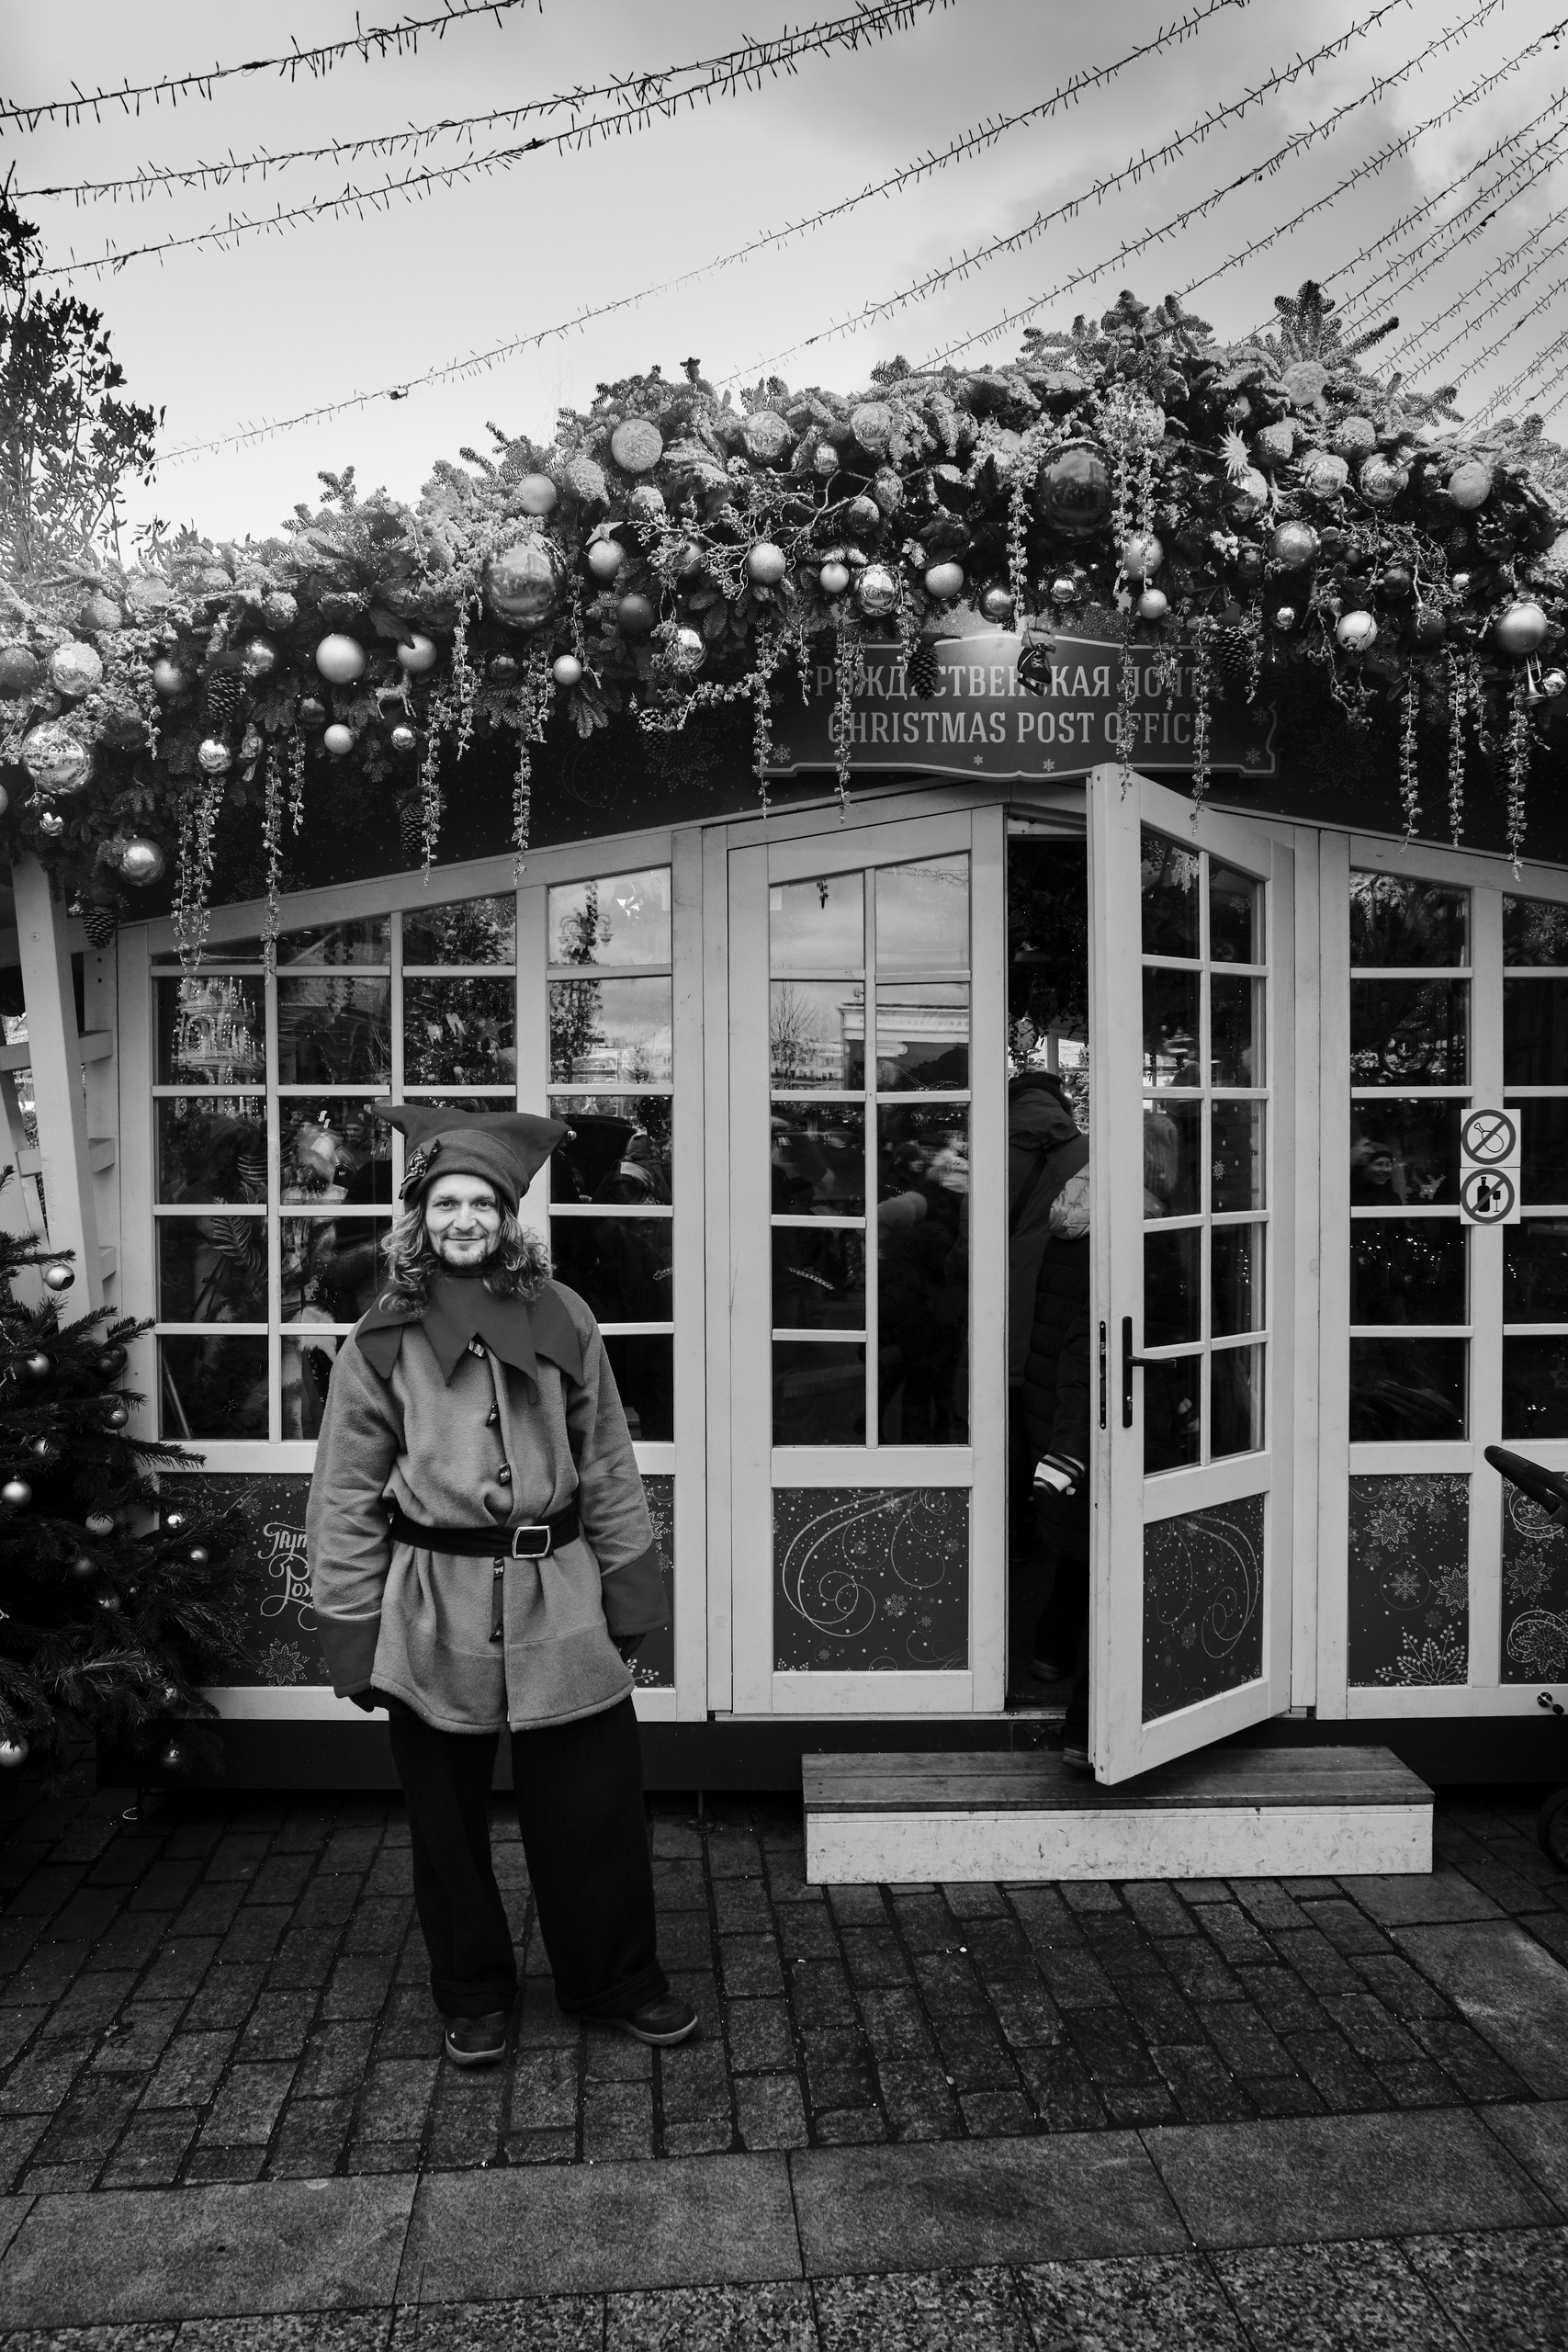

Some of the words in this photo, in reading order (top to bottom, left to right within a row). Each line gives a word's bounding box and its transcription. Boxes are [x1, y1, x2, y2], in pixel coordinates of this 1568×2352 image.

[815, 665, 1111, 701] РОЖДСТВЕНКАЯ
[828, 711, 1006, 744] CHRISTMAS
[1016, 711, 1095, 744] POST
